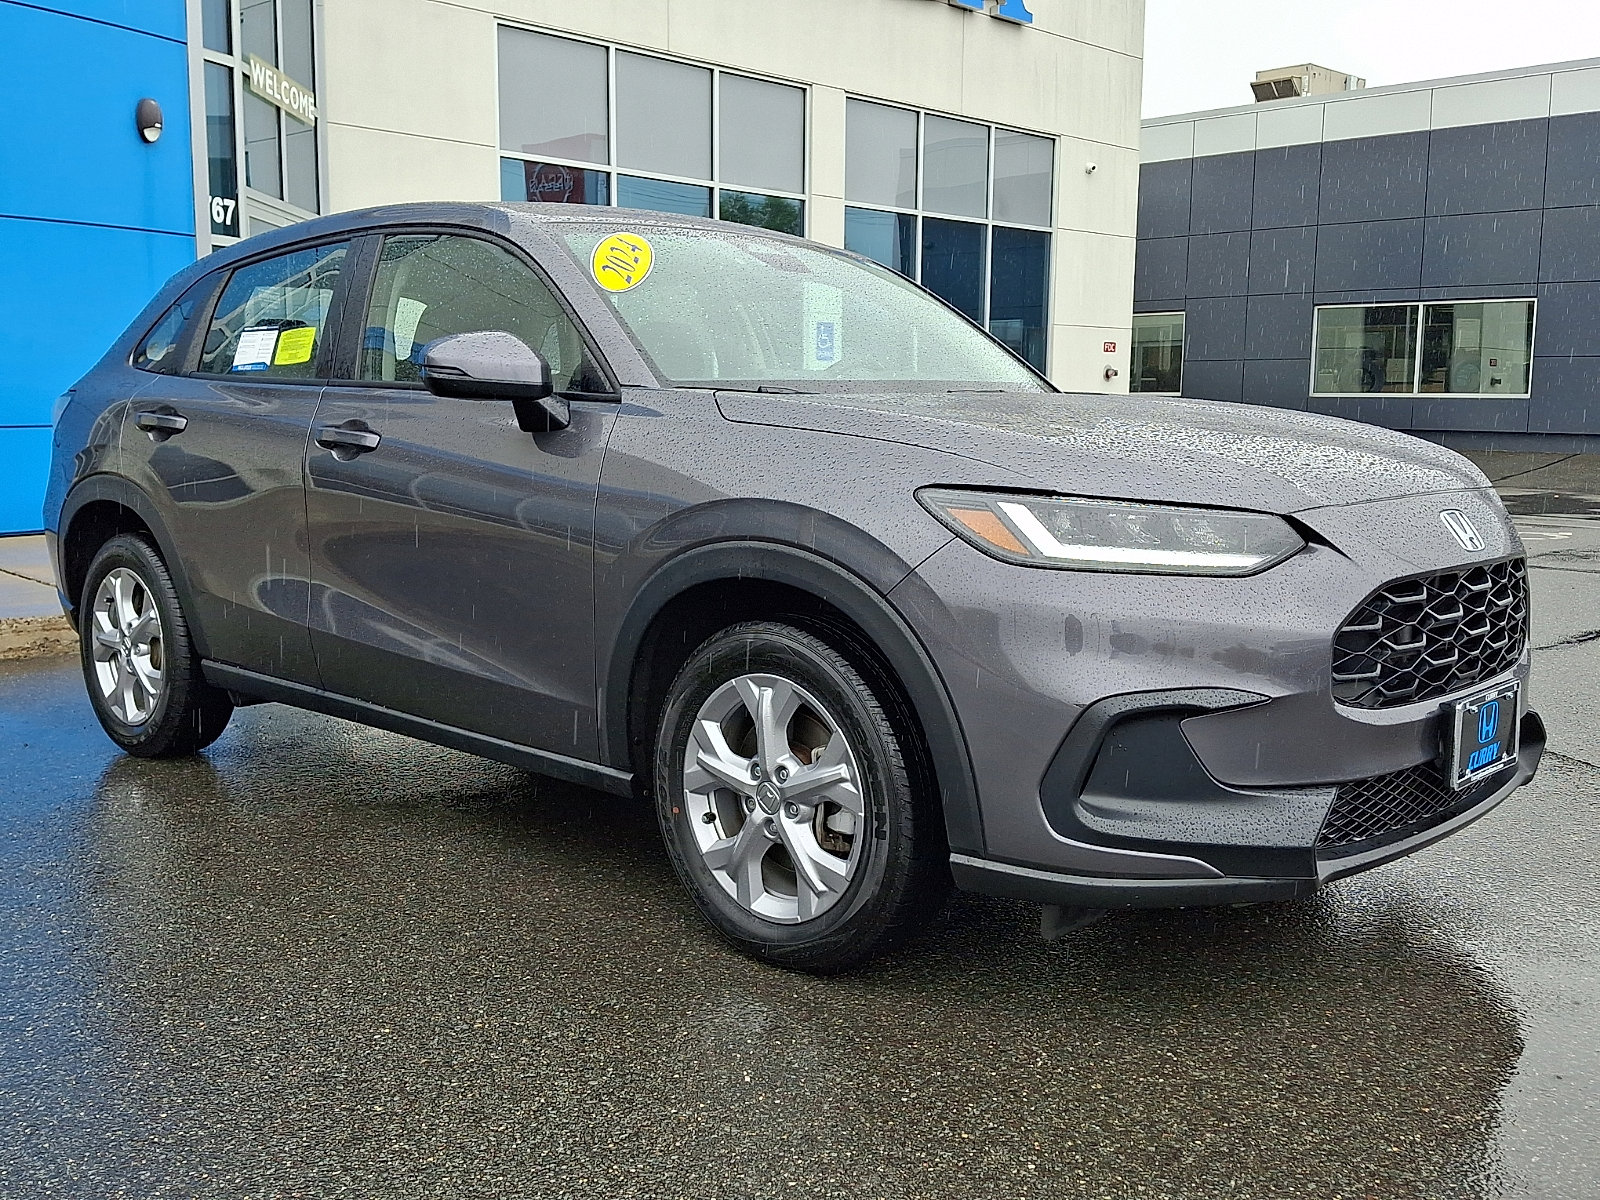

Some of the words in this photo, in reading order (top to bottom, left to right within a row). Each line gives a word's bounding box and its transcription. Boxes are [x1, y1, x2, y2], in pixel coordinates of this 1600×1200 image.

[250, 59, 315, 121] WELCOME
[208, 195, 236, 226] 67
[601, 236, 643, 285] 2024
[1104, 342, 1115, 352] FDC
[1468, 742, 1500, 770] CURRY
